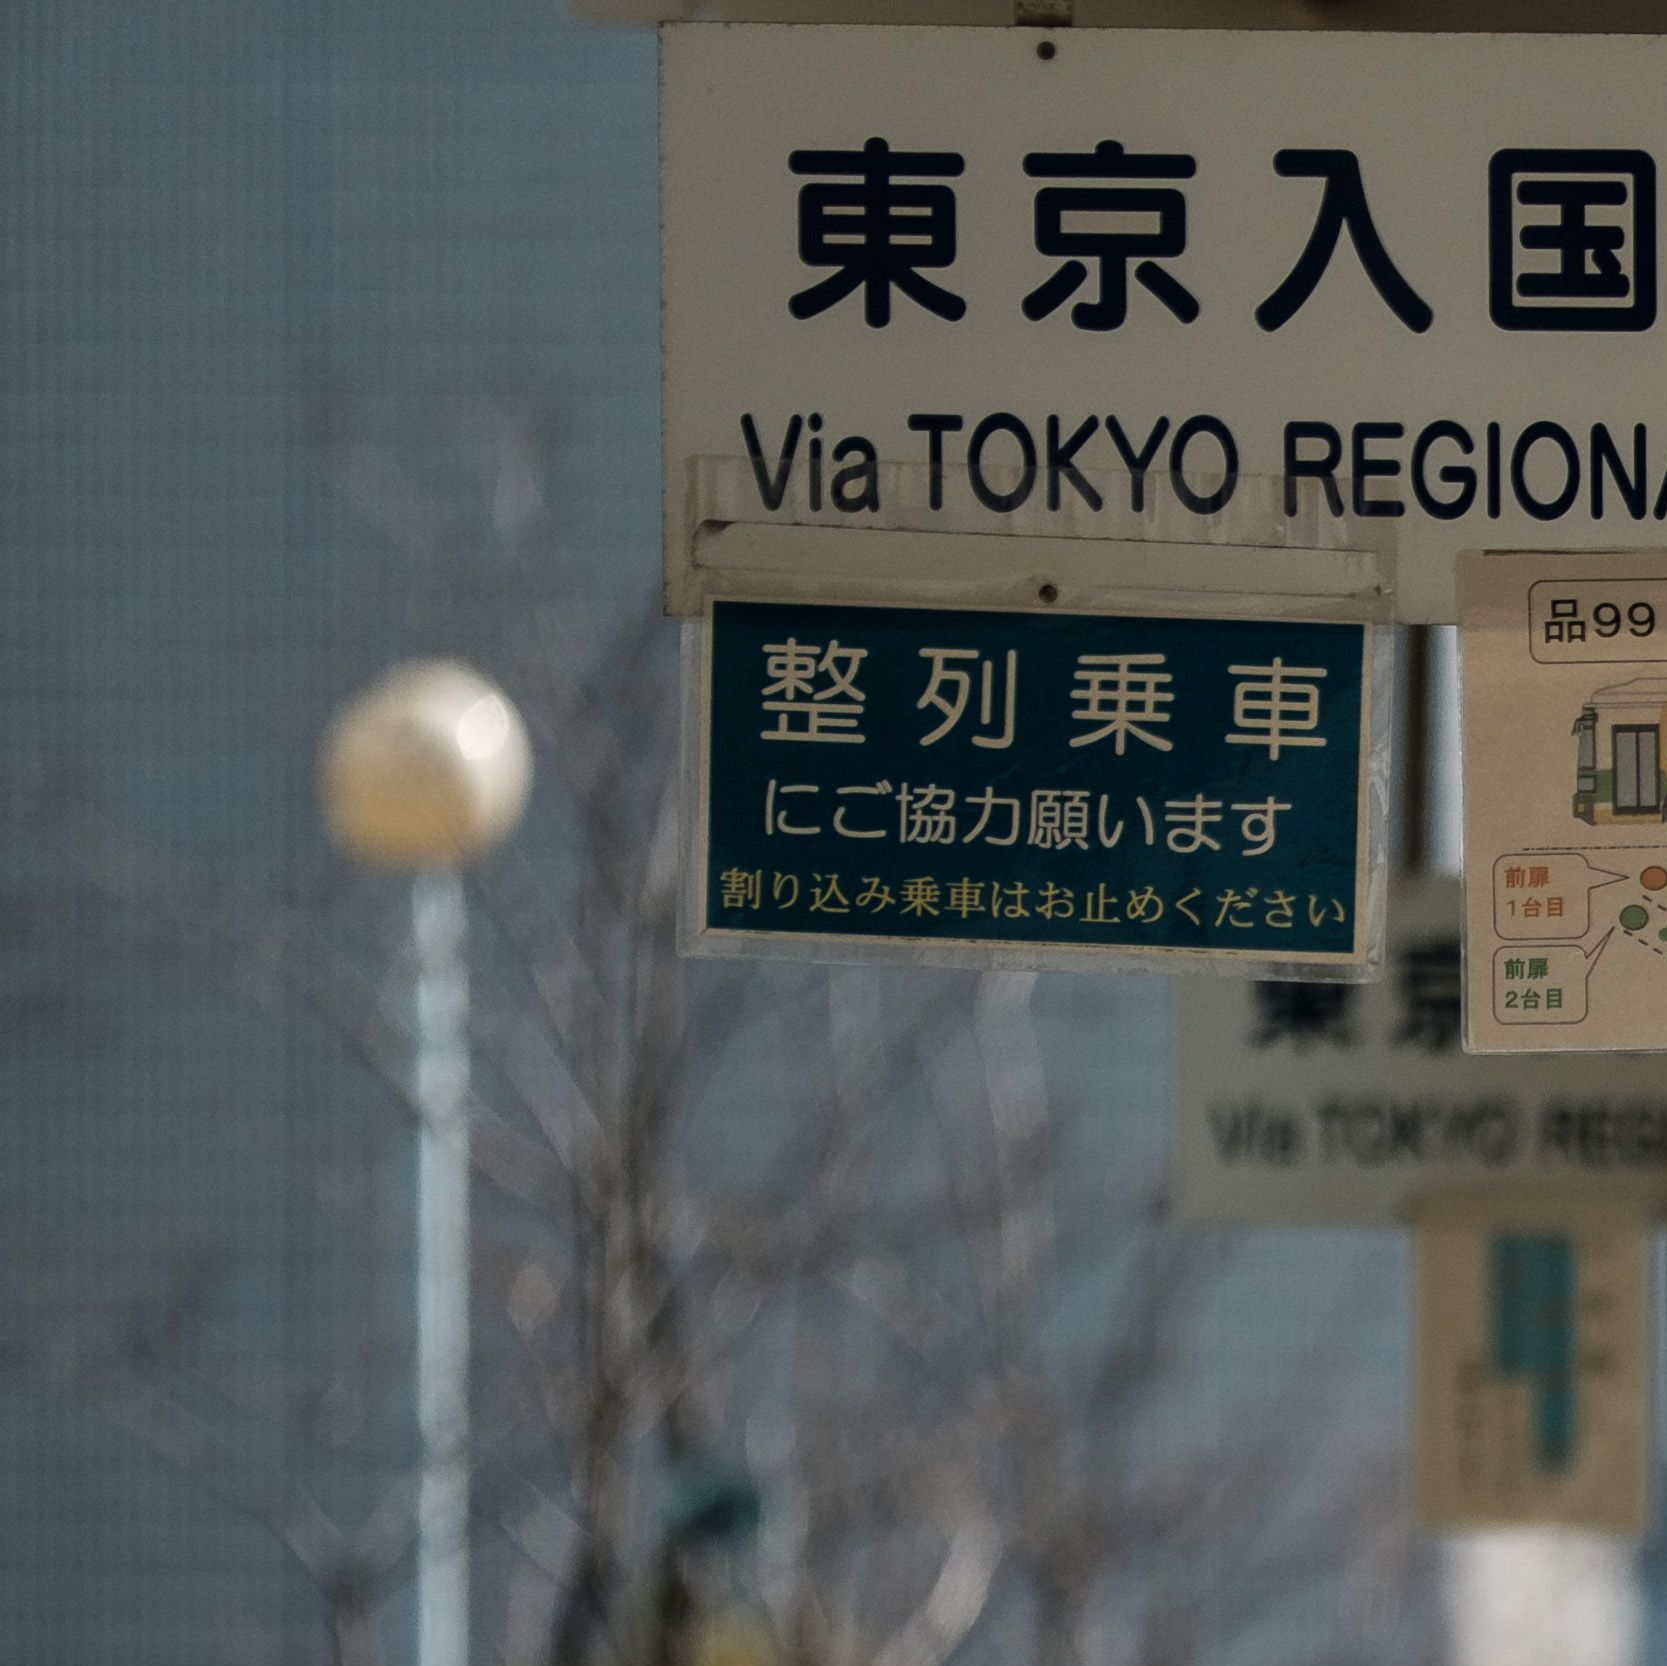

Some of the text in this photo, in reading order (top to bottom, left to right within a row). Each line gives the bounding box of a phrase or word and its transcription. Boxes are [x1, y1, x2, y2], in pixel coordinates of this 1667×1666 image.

[740, 413, 880, 514] Via
[908, 411, 1239, 517] TOKYO
[1544, 597, 1658, 645] 品99
[759, 636, 1328, 761] 整列乗車
[764, 778, 1293, 857] にご協力願います
[720, 867, 1347, 929] 割り込み乗車はお止めください
[1503, 864, 1551, 890] 前扉
[1506, 895, 1566, 919] 1台目
[1503, 957, 1550, 981] 前扉
[1504, 986, 1566, 1011] 2台目
